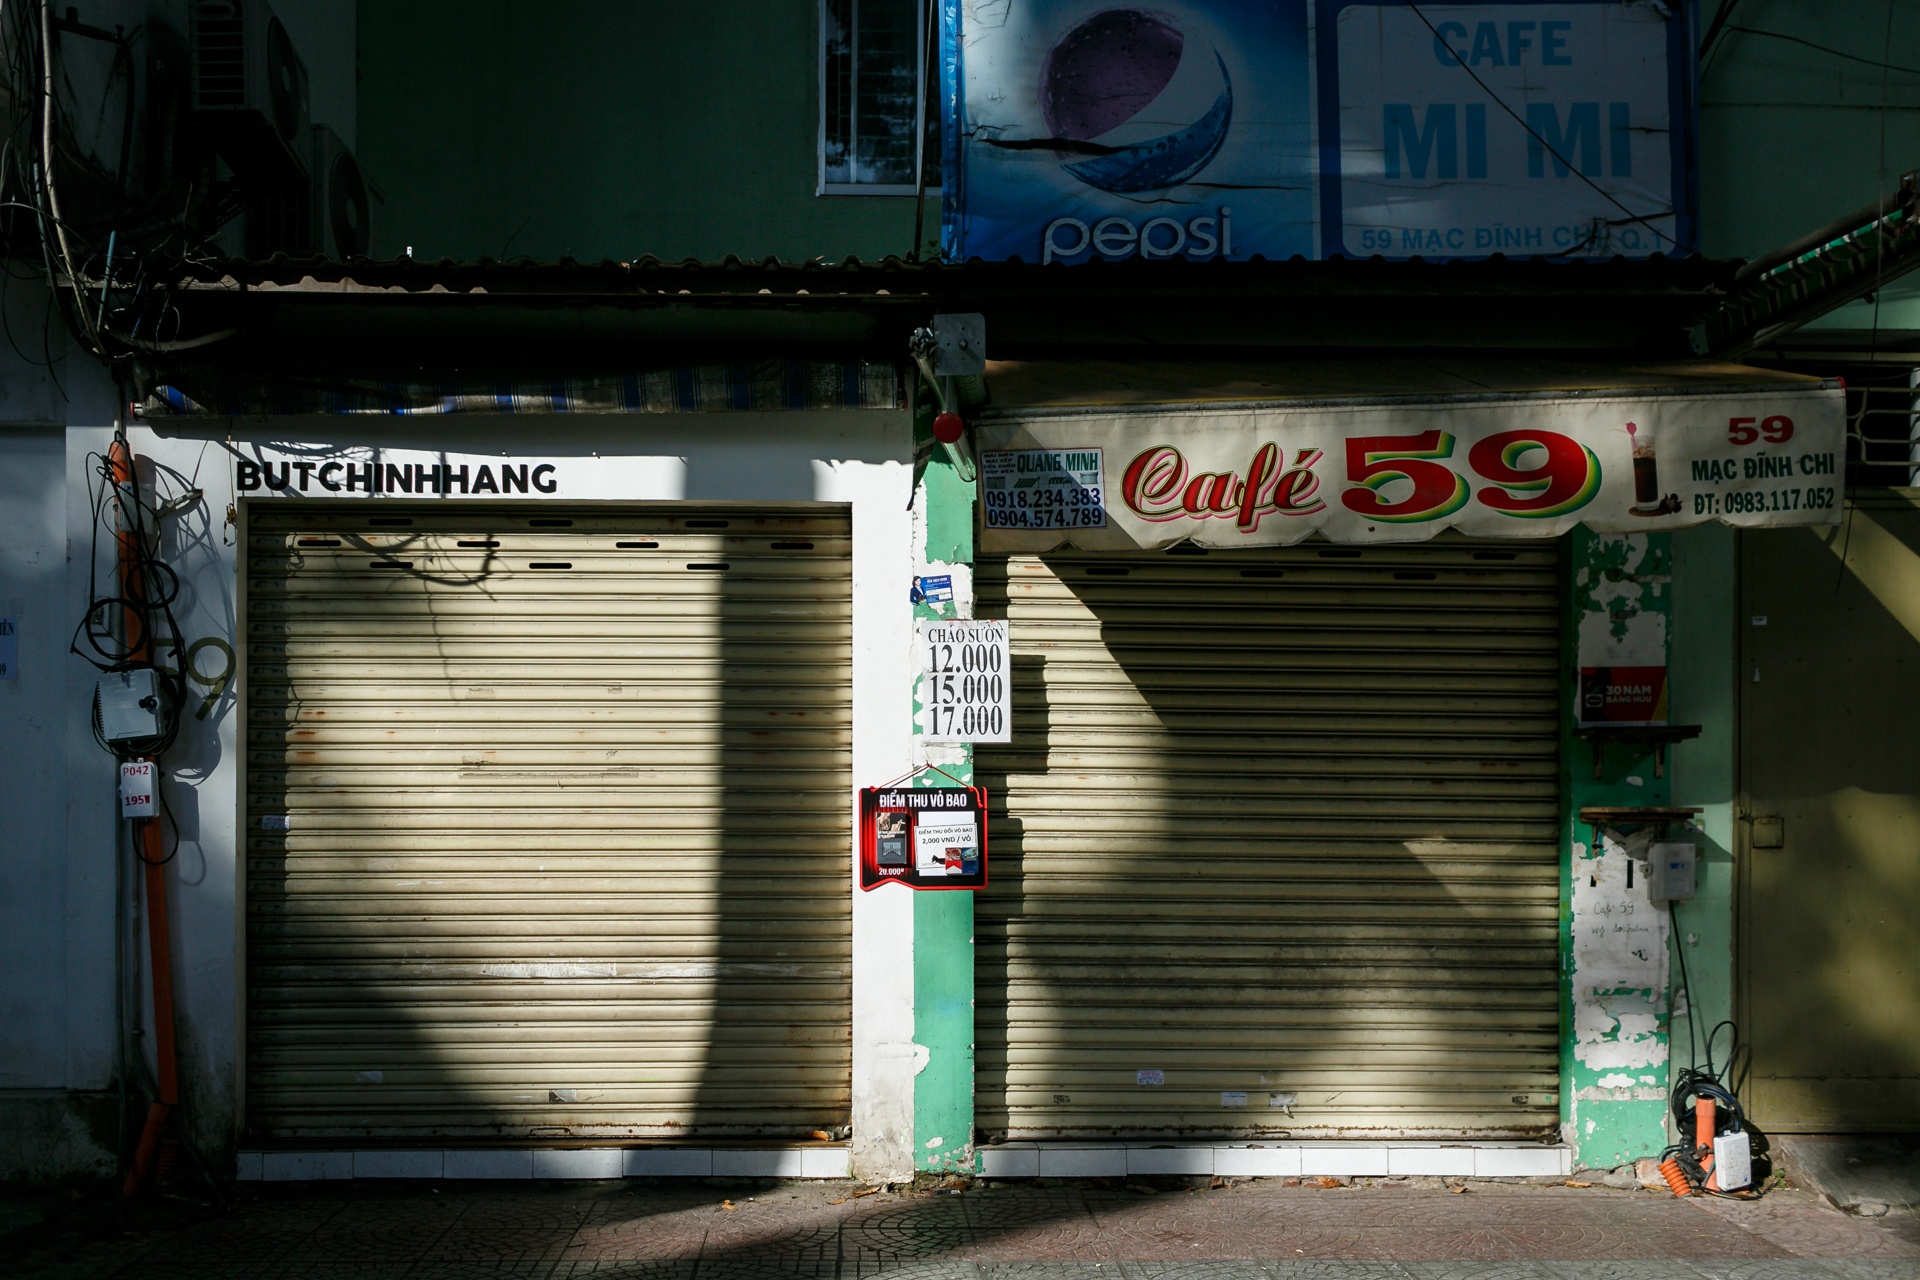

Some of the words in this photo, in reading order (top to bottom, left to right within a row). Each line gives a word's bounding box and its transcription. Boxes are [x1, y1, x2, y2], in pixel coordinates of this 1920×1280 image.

[1433, 20, 1572, 67] CAFE
[1383, 103, 1488, 179] MI
[1526, 102, 1632, 178] MI
[1043, 206, 1232, 266] pepsi
[1361, 229, 1392, 250] 59
[1402, 228, 1464, 254] MẠC
[1728, 415, 1795, 446] 59
[236, 461, 557, 494] BUTCHINHHANG
[1017, 453, 1061, 475] QUANG
[1065, 452, 1098, 471] MINH
[1691, 458, 1737, 485] MẠC
[1743, 452, 1793, 479] ĐĨNH
[1800, 453, 1835, 475] CHI
[1120, 440, 1326, 534] Café
[1341, 429, 1603, 524] 59
[986, 488, 1101, 509] 0918.234.383
[1694, 492, 1720, 515] ĐT:
[1724, 487, 1835, 514] 0983.117.052
[988, 508, 1102, 527] 0904.574.789
[928, 624, 965, 643] CHÁO
[968, 624, 1004, 643] SƯỜN
[928, 644, 1002, 673] 12.000
[929, 674, 1003, 704] 15.000
[1606, 685, 1622, 695] 30
[929, 705, 1003, 735] 17.000
[123, 765, 149, 776] P042
[879, 789, 905, 808] ĐIỂM
[907, 794, 928, 808] THU
[930, 789, 944, 808] VỎ
[946, 793, 967, 807] BAO
